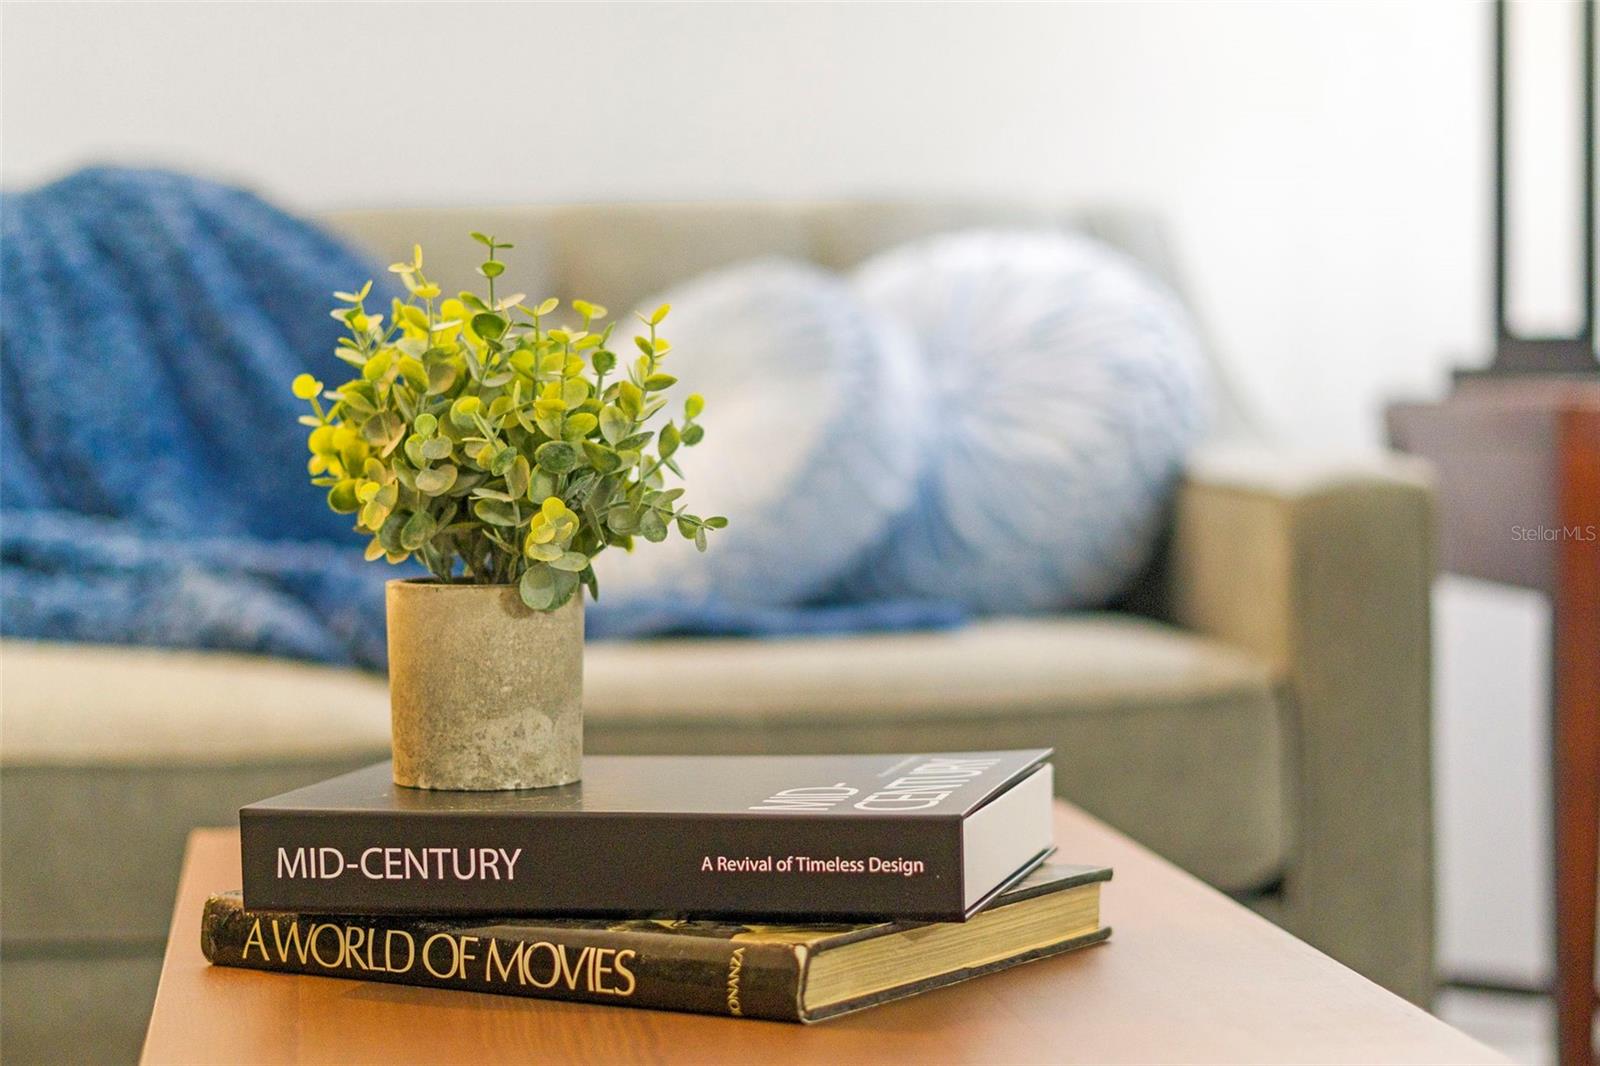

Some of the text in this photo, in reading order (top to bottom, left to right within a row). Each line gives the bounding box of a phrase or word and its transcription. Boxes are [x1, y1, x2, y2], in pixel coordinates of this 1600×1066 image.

[748, 782, 860, 811] MID-
[854, 757, 1001, 811] CENTURY
[276, 846, 523, 881] MID-CENTURY
[701, 855, 925, 877] A Revival of Timeless Design
[241, 917, 637, 997] A WORLD OF MOVIES
